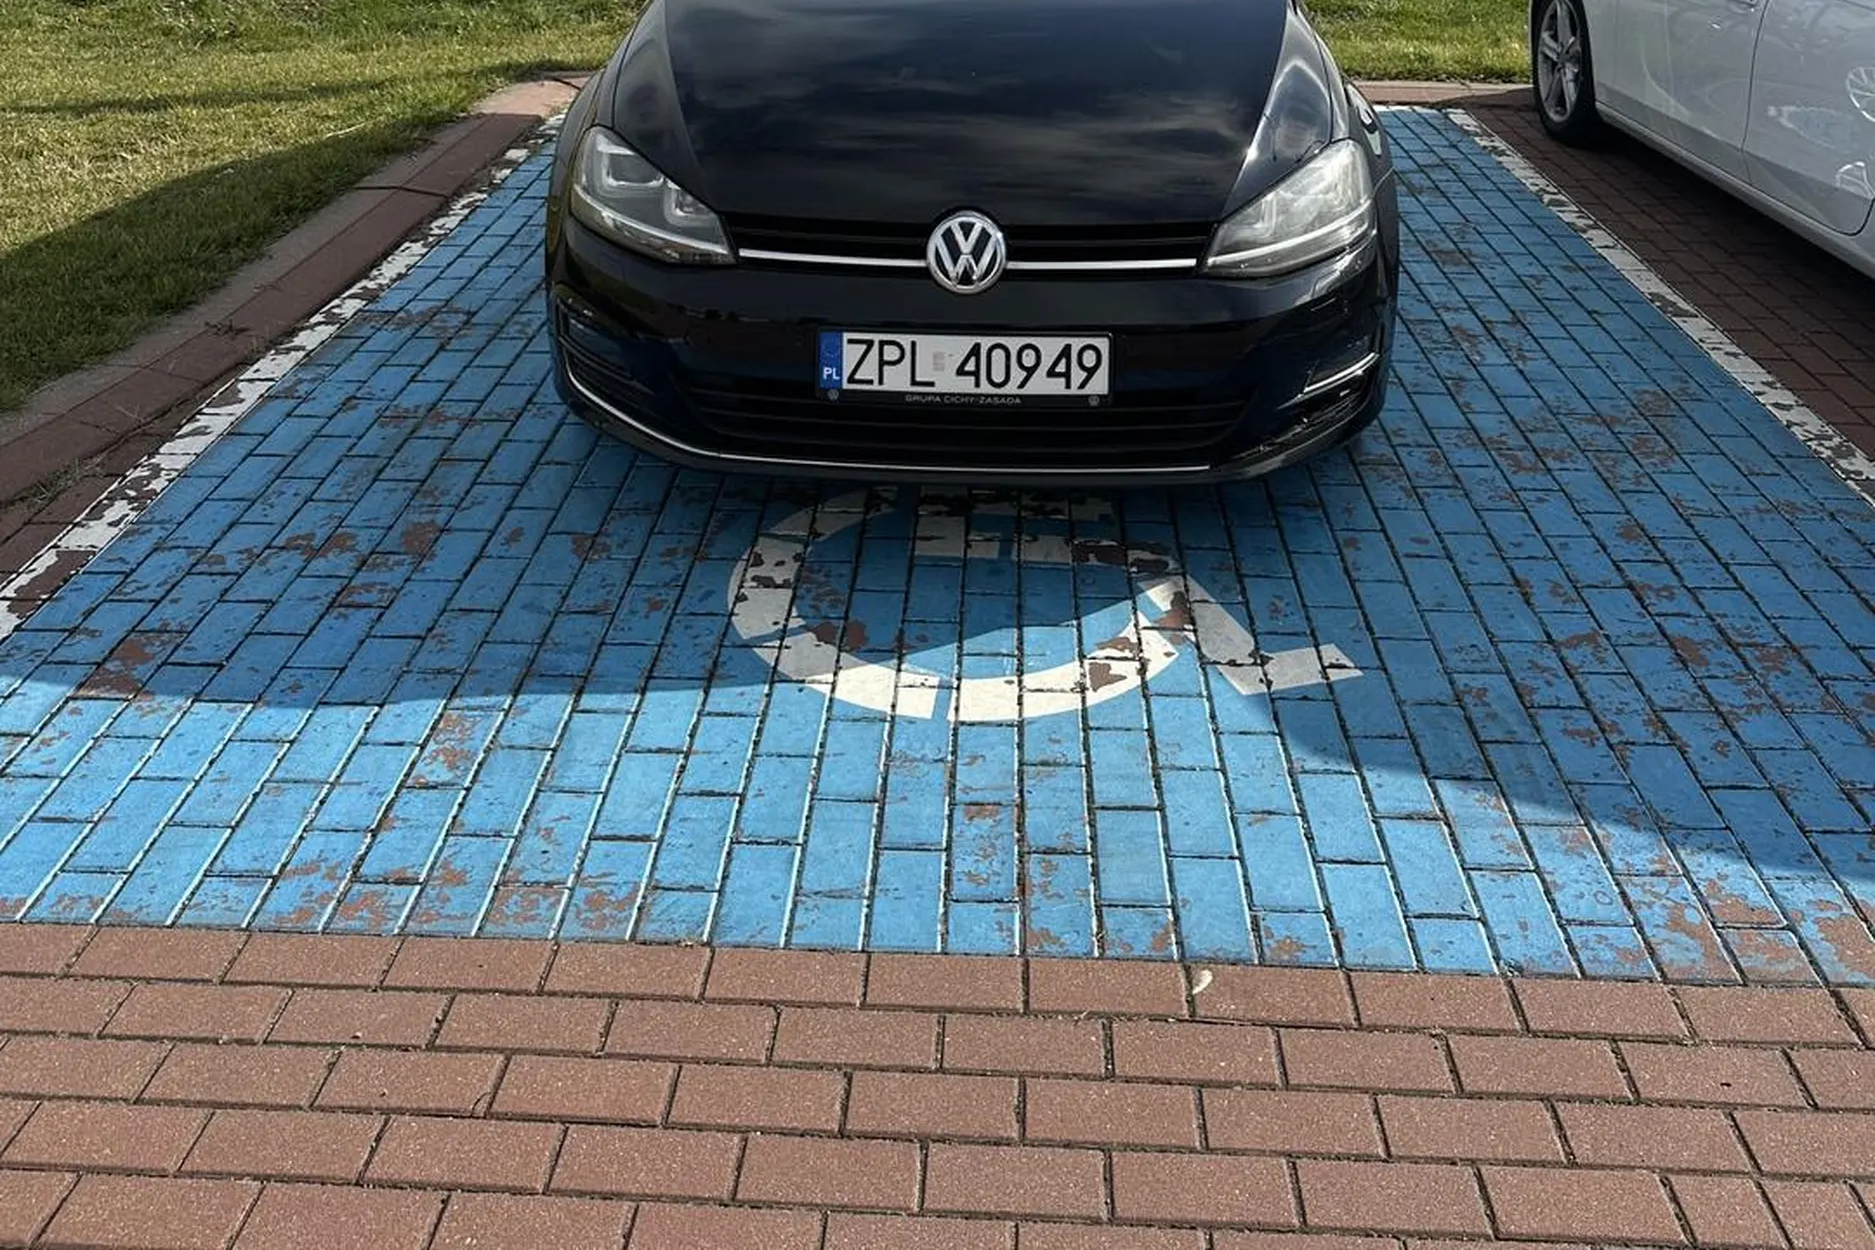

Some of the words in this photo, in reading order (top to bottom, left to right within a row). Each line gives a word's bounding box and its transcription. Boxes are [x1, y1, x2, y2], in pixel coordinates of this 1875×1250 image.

[847, 338, 936, 387] ZPL
[956, 343, 1103, 390] 40949
[823, 366, 840, 380] PL
[904, 394, 941, 404] GRUPA
